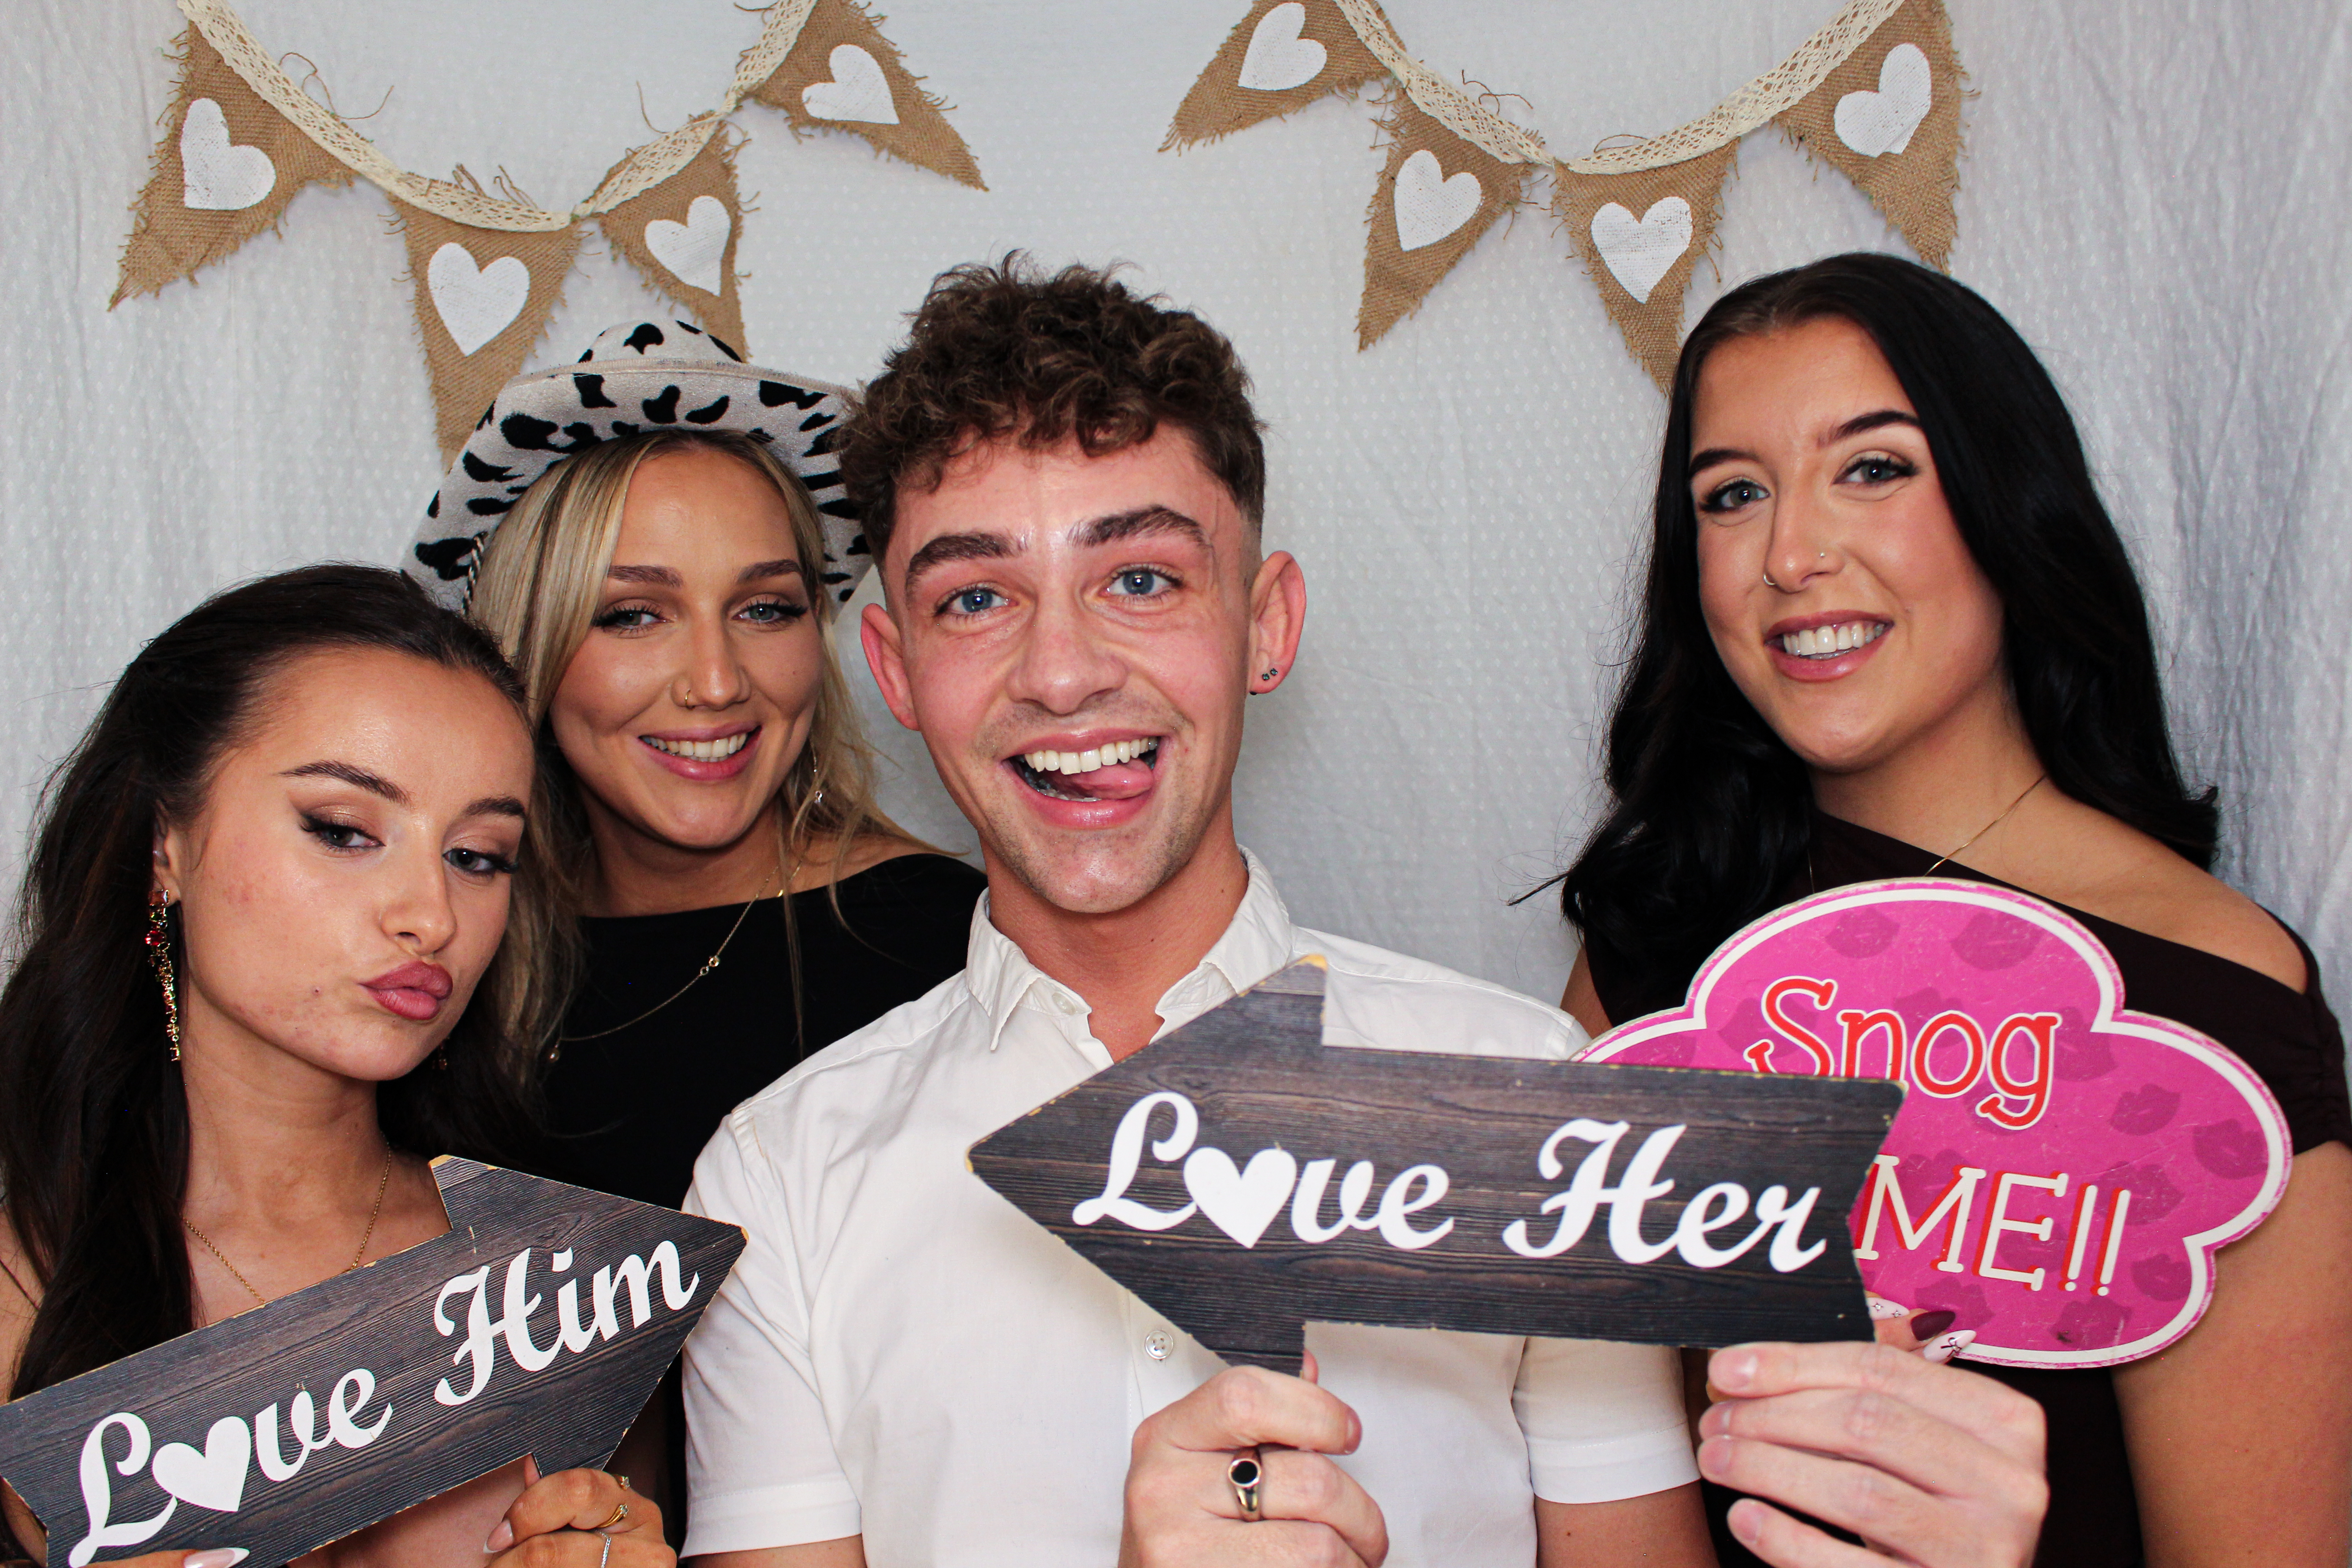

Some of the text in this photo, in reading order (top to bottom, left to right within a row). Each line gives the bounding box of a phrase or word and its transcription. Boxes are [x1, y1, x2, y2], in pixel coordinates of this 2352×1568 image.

[1743, 975, 2062, 1131] Snog
[1503, 1118, 1827, 1272] Her
[1854, 1154, 2130, 1296] ME!!
[434, 1241, 699, 1406] Him
